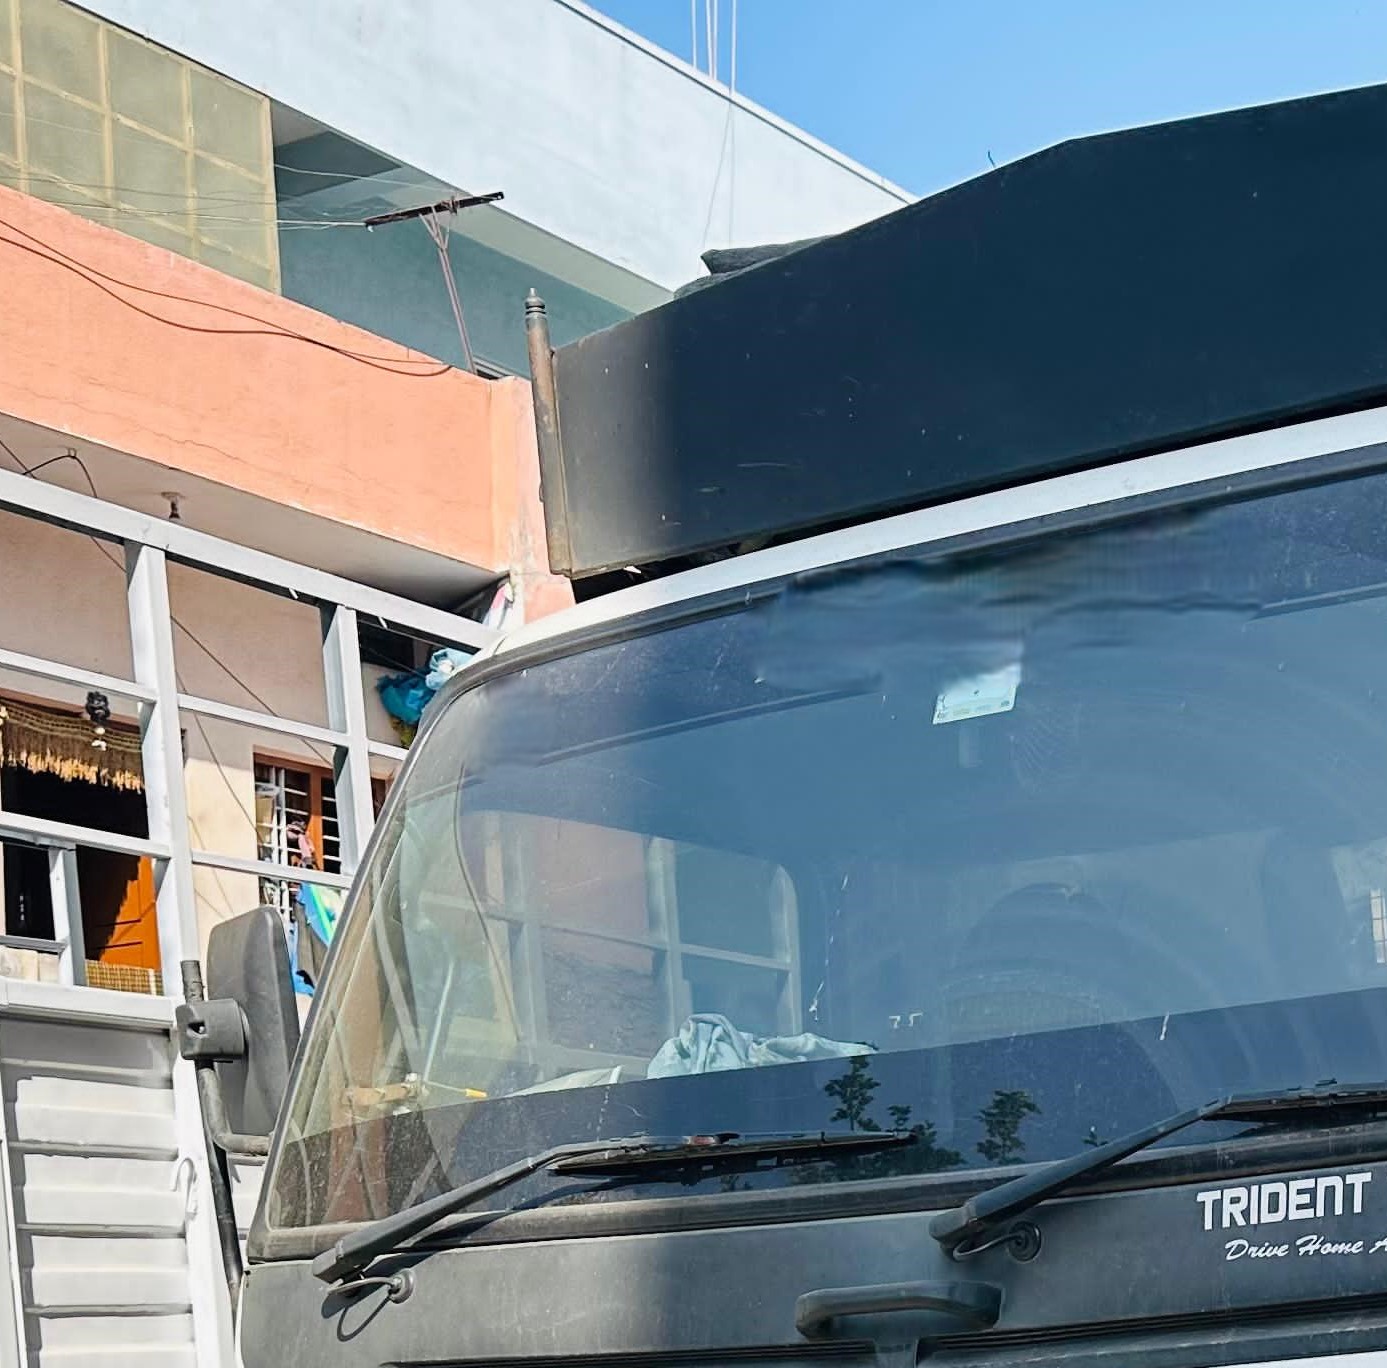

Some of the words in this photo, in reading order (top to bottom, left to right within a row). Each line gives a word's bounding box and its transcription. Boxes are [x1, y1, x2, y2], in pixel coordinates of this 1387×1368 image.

[1197, 1172, 1372, 1230] TRIDENT
[1225, 1239, 1289, 1262] Drive
[1297, 1234, 1364, 1257] Home
